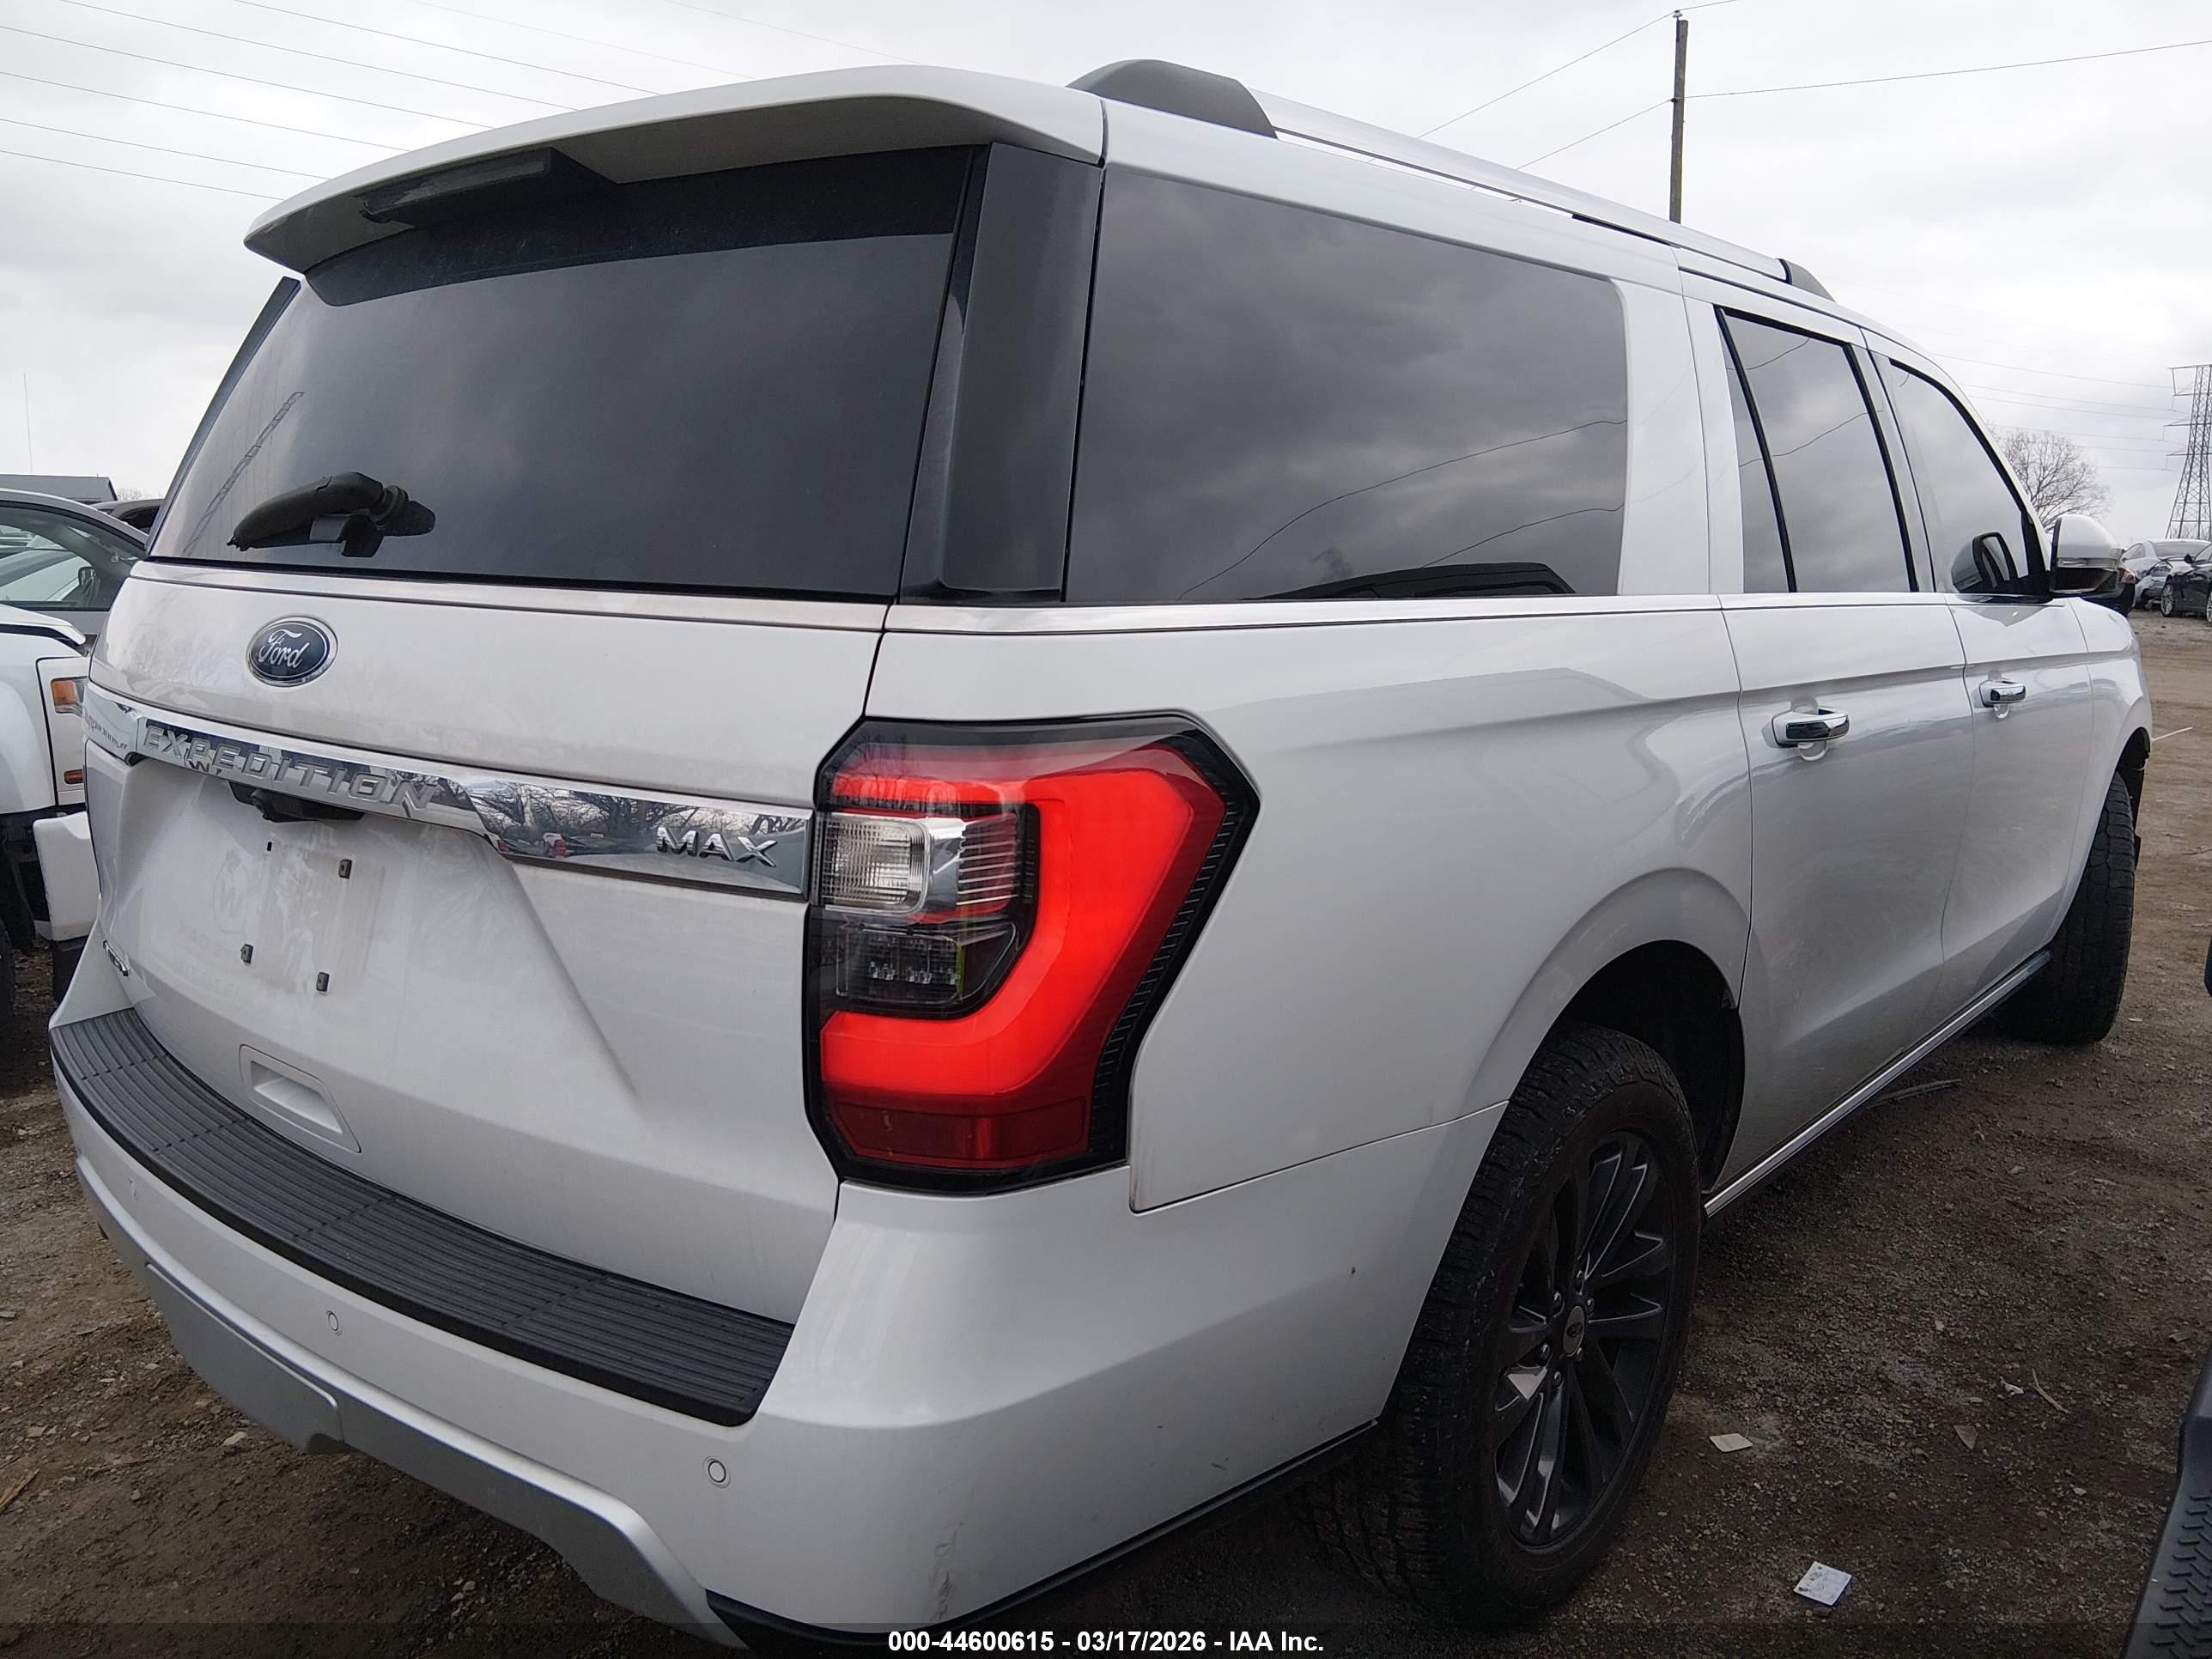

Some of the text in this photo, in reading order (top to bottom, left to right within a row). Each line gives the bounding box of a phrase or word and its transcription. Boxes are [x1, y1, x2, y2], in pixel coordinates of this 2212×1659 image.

[258, 628, 310, 669] Ford
[143, 725, 778, 868] EXPEDITION MAX
